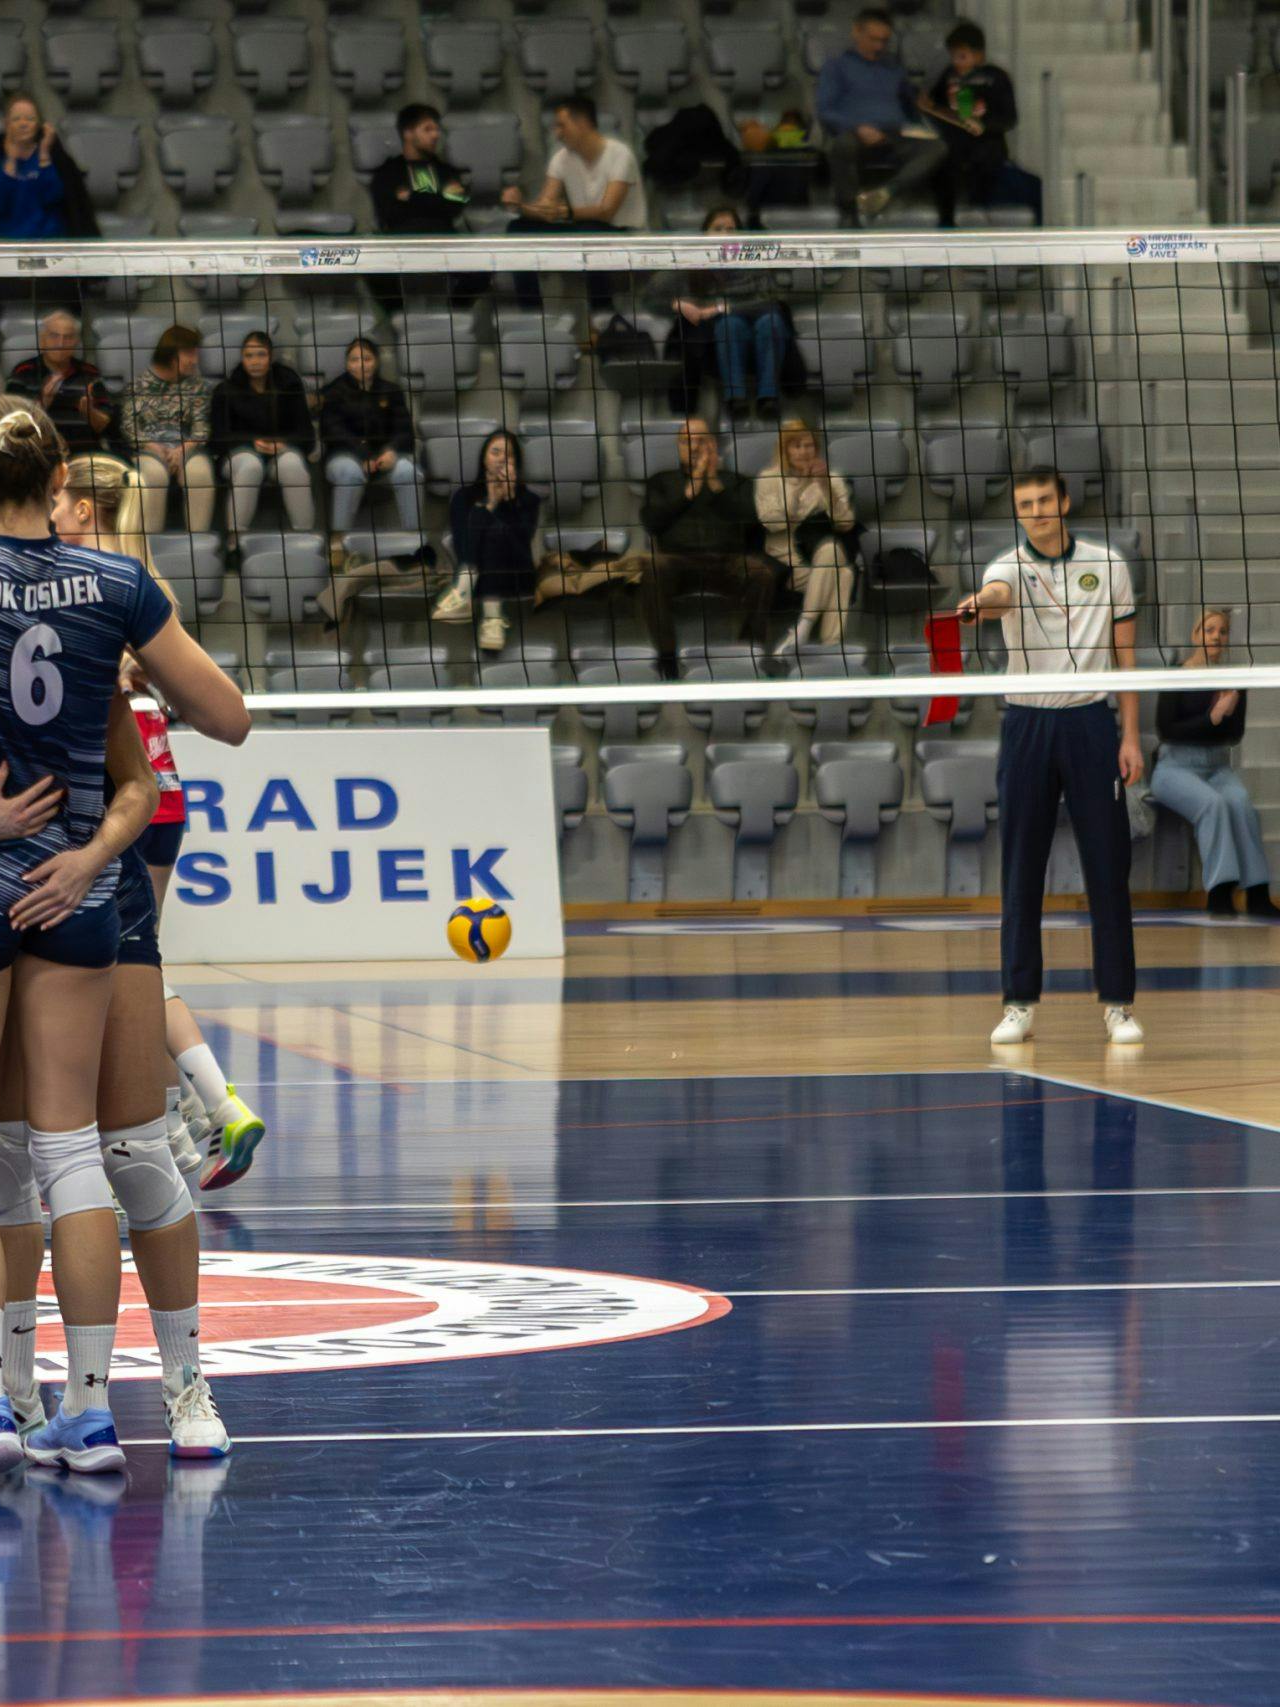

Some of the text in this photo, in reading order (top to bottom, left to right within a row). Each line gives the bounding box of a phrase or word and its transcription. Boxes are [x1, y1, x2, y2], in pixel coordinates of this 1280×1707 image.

[318, 257, 341, 266] LIGA
[1149, 250, 1178, 259] SAVEZ
[24, 575, 103, 612] OSIJEK
[10, 624, 64, 726] 6
[182, 778, 400, 833] RAD
[175, 847, 515, 906] SIJEK
